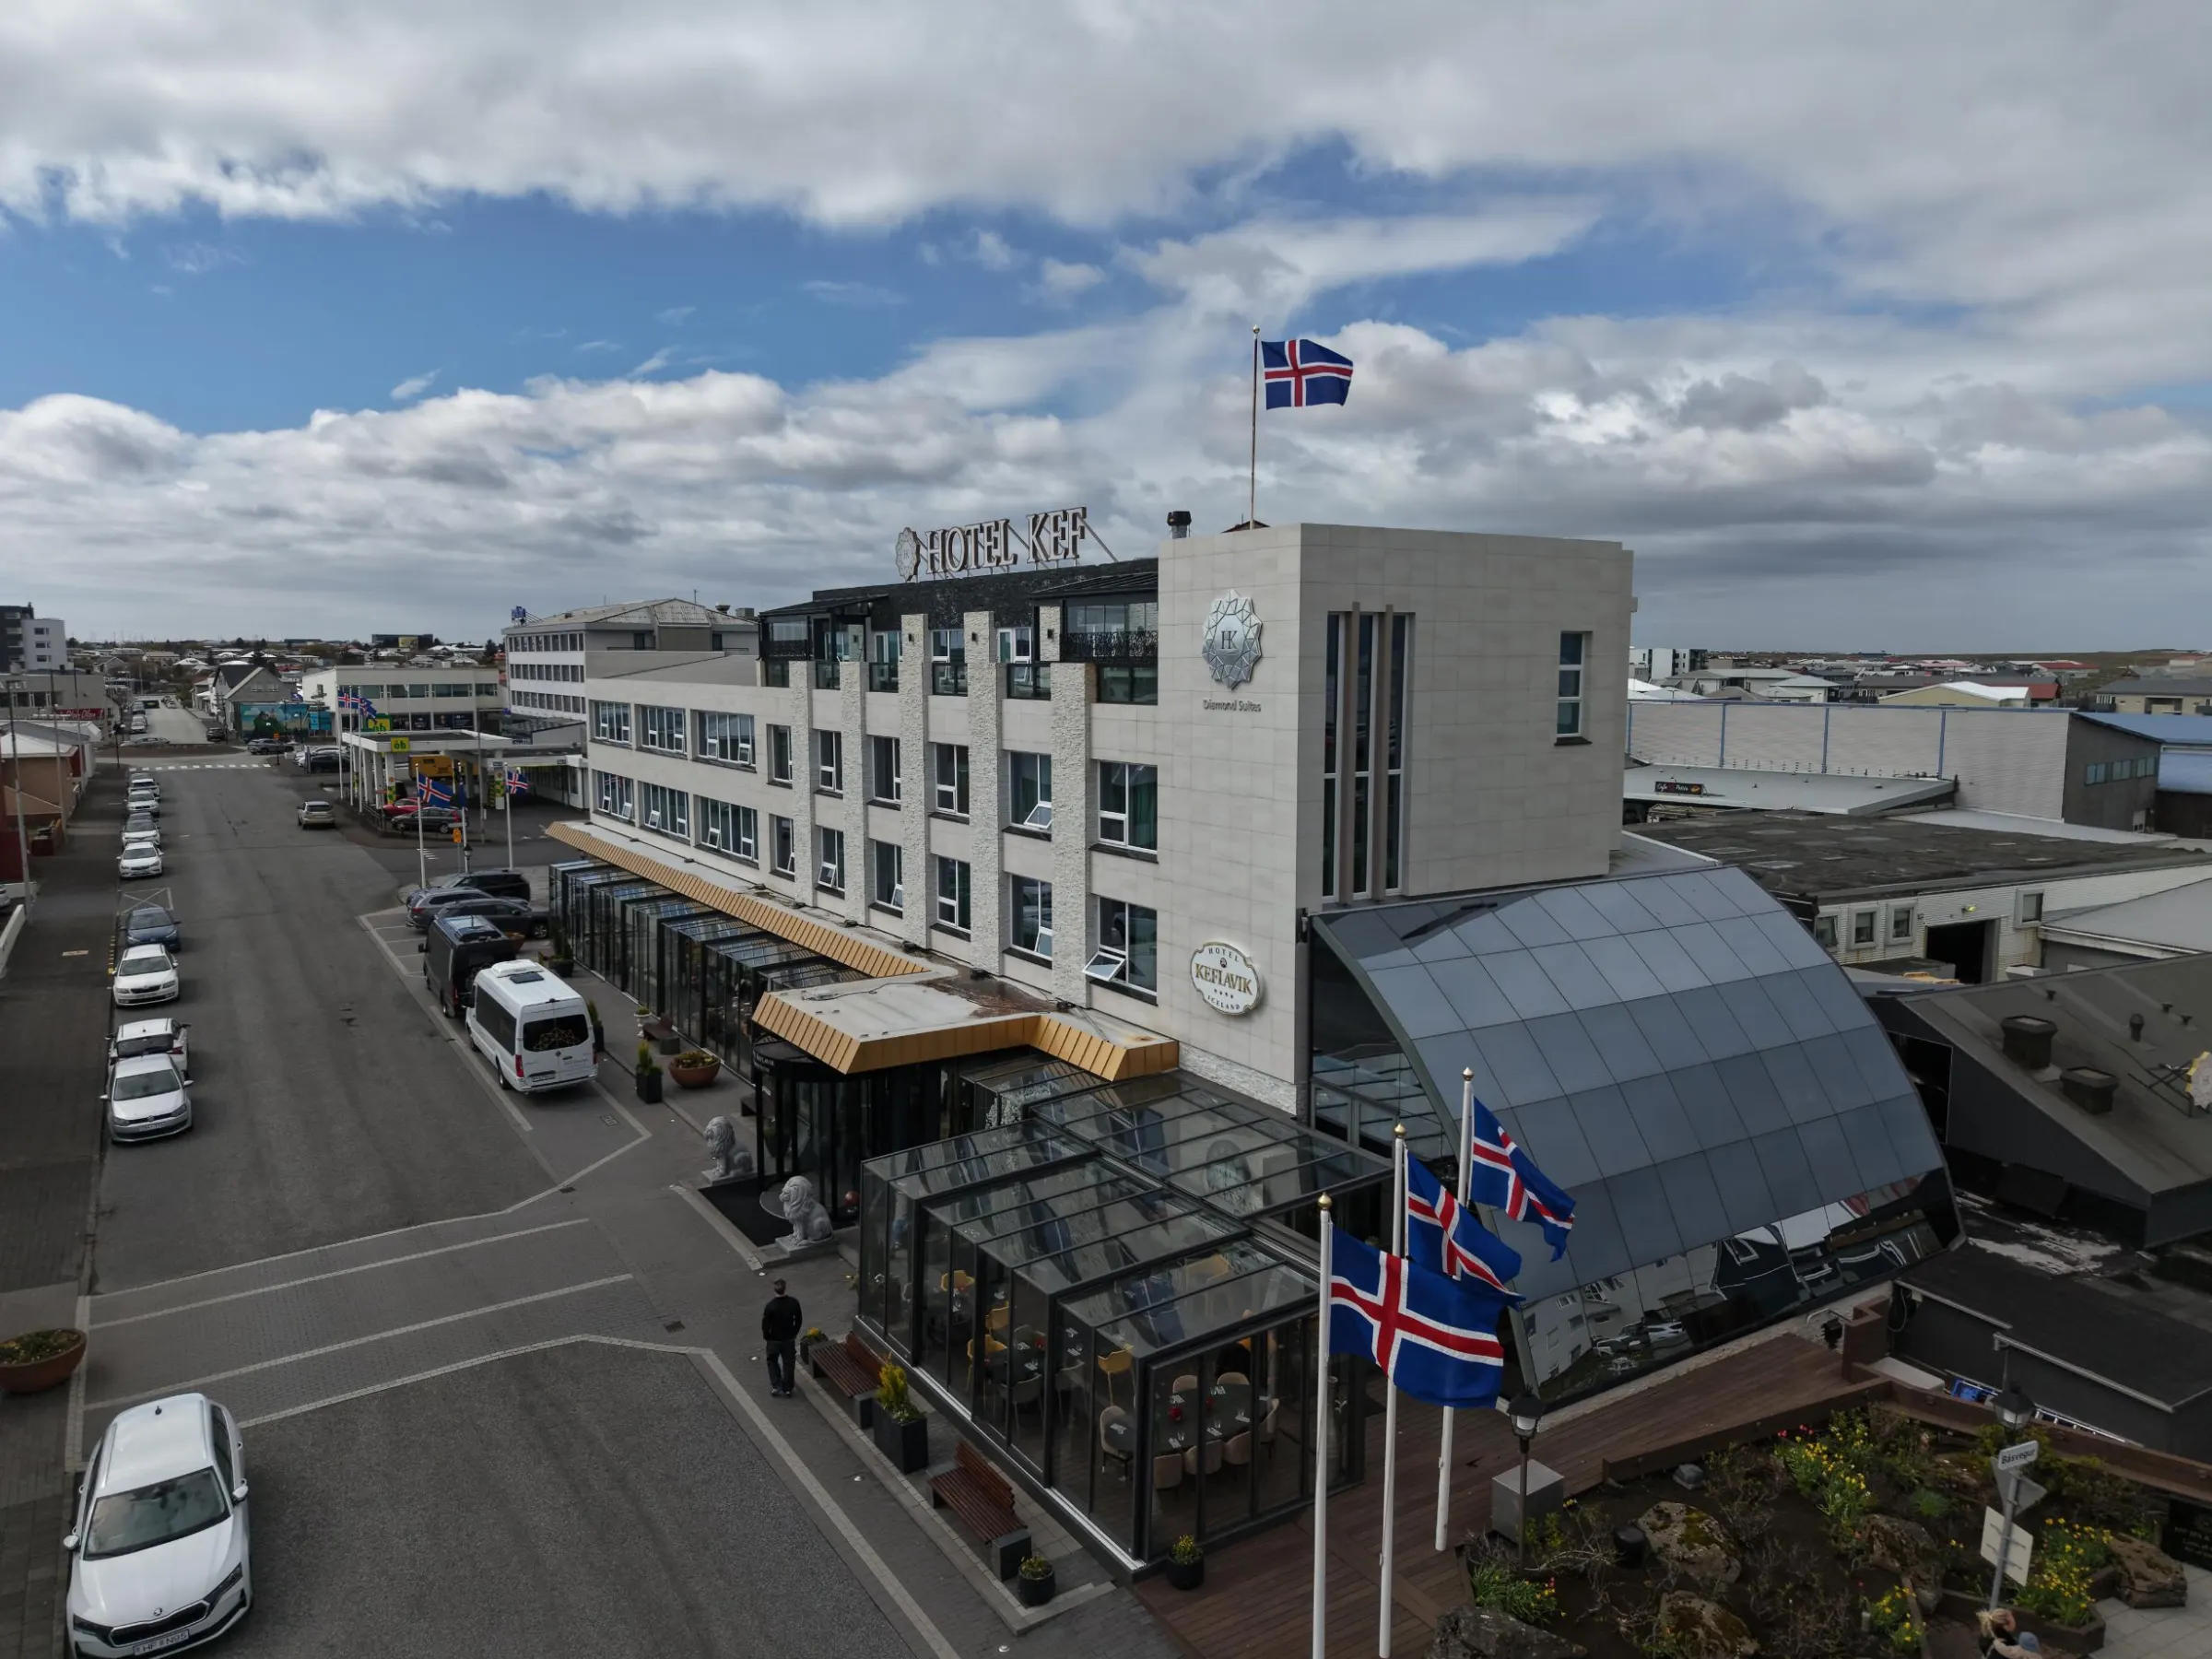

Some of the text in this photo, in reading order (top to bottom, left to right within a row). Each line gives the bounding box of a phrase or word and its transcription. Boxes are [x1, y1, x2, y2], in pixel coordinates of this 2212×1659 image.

[925, 507, 1087, 574] HOTEL KEF
[1203, 699, 1262, 712] Diamond Suites
[1208, 947, 1239, 962] HOTEL
[1195, 963, 1253, 995] KEFLAVIK
[1207, 995, 1240, 1010] ICELAND
